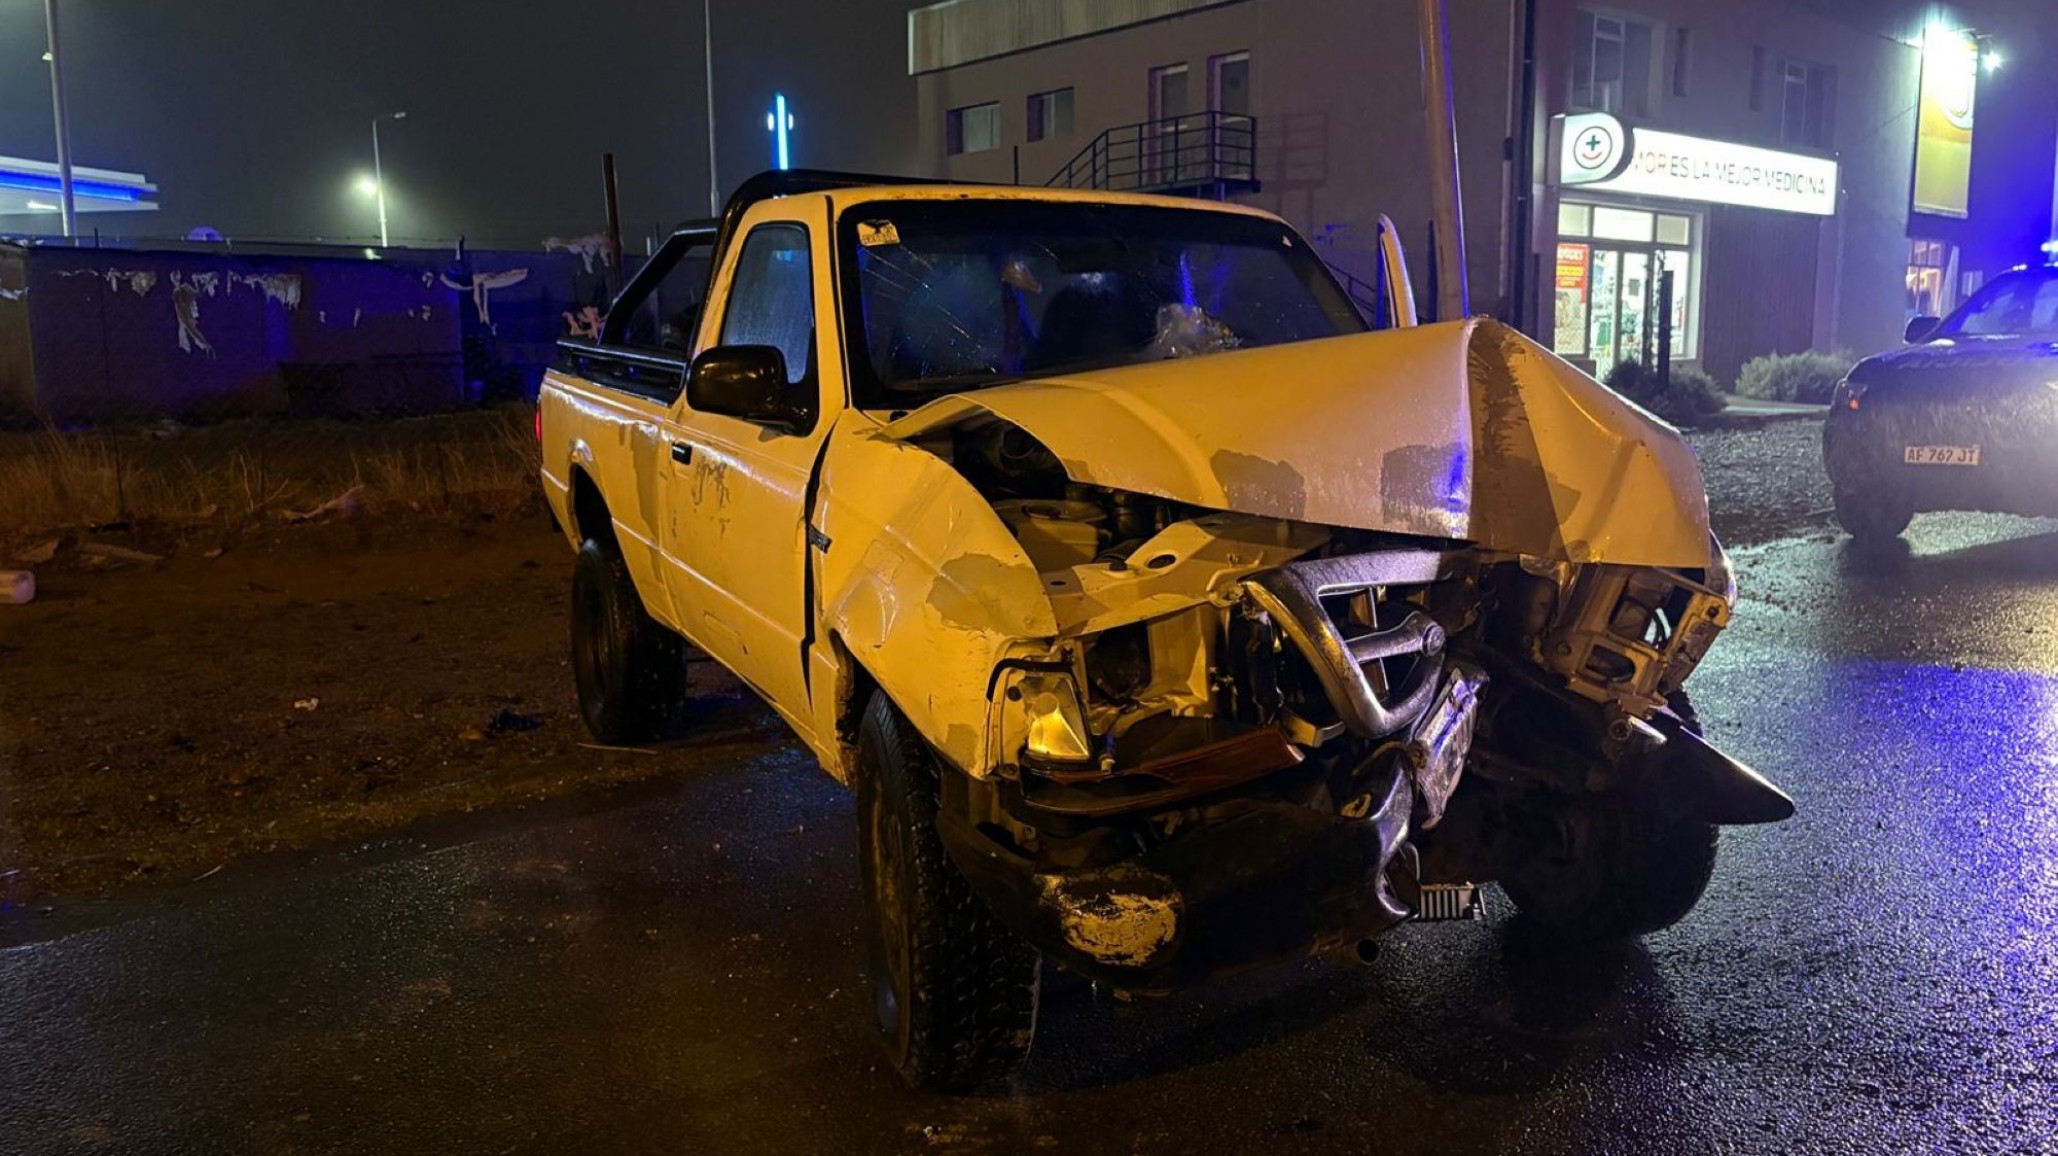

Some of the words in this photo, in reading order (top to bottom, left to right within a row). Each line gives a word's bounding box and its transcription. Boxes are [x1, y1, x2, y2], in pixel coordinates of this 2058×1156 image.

[1670, 155, 1689, 178] ES
[1693, 159, 1710, 180] LA
[1715, 162, 1761, 187] MEJOR
[1763, 168, 1826, 195] MEDICINA
[1908, 448, 1923, 462] AF
[1929, 448, 1954, 462] 767
[1957, 449, 1976, 463] JT
